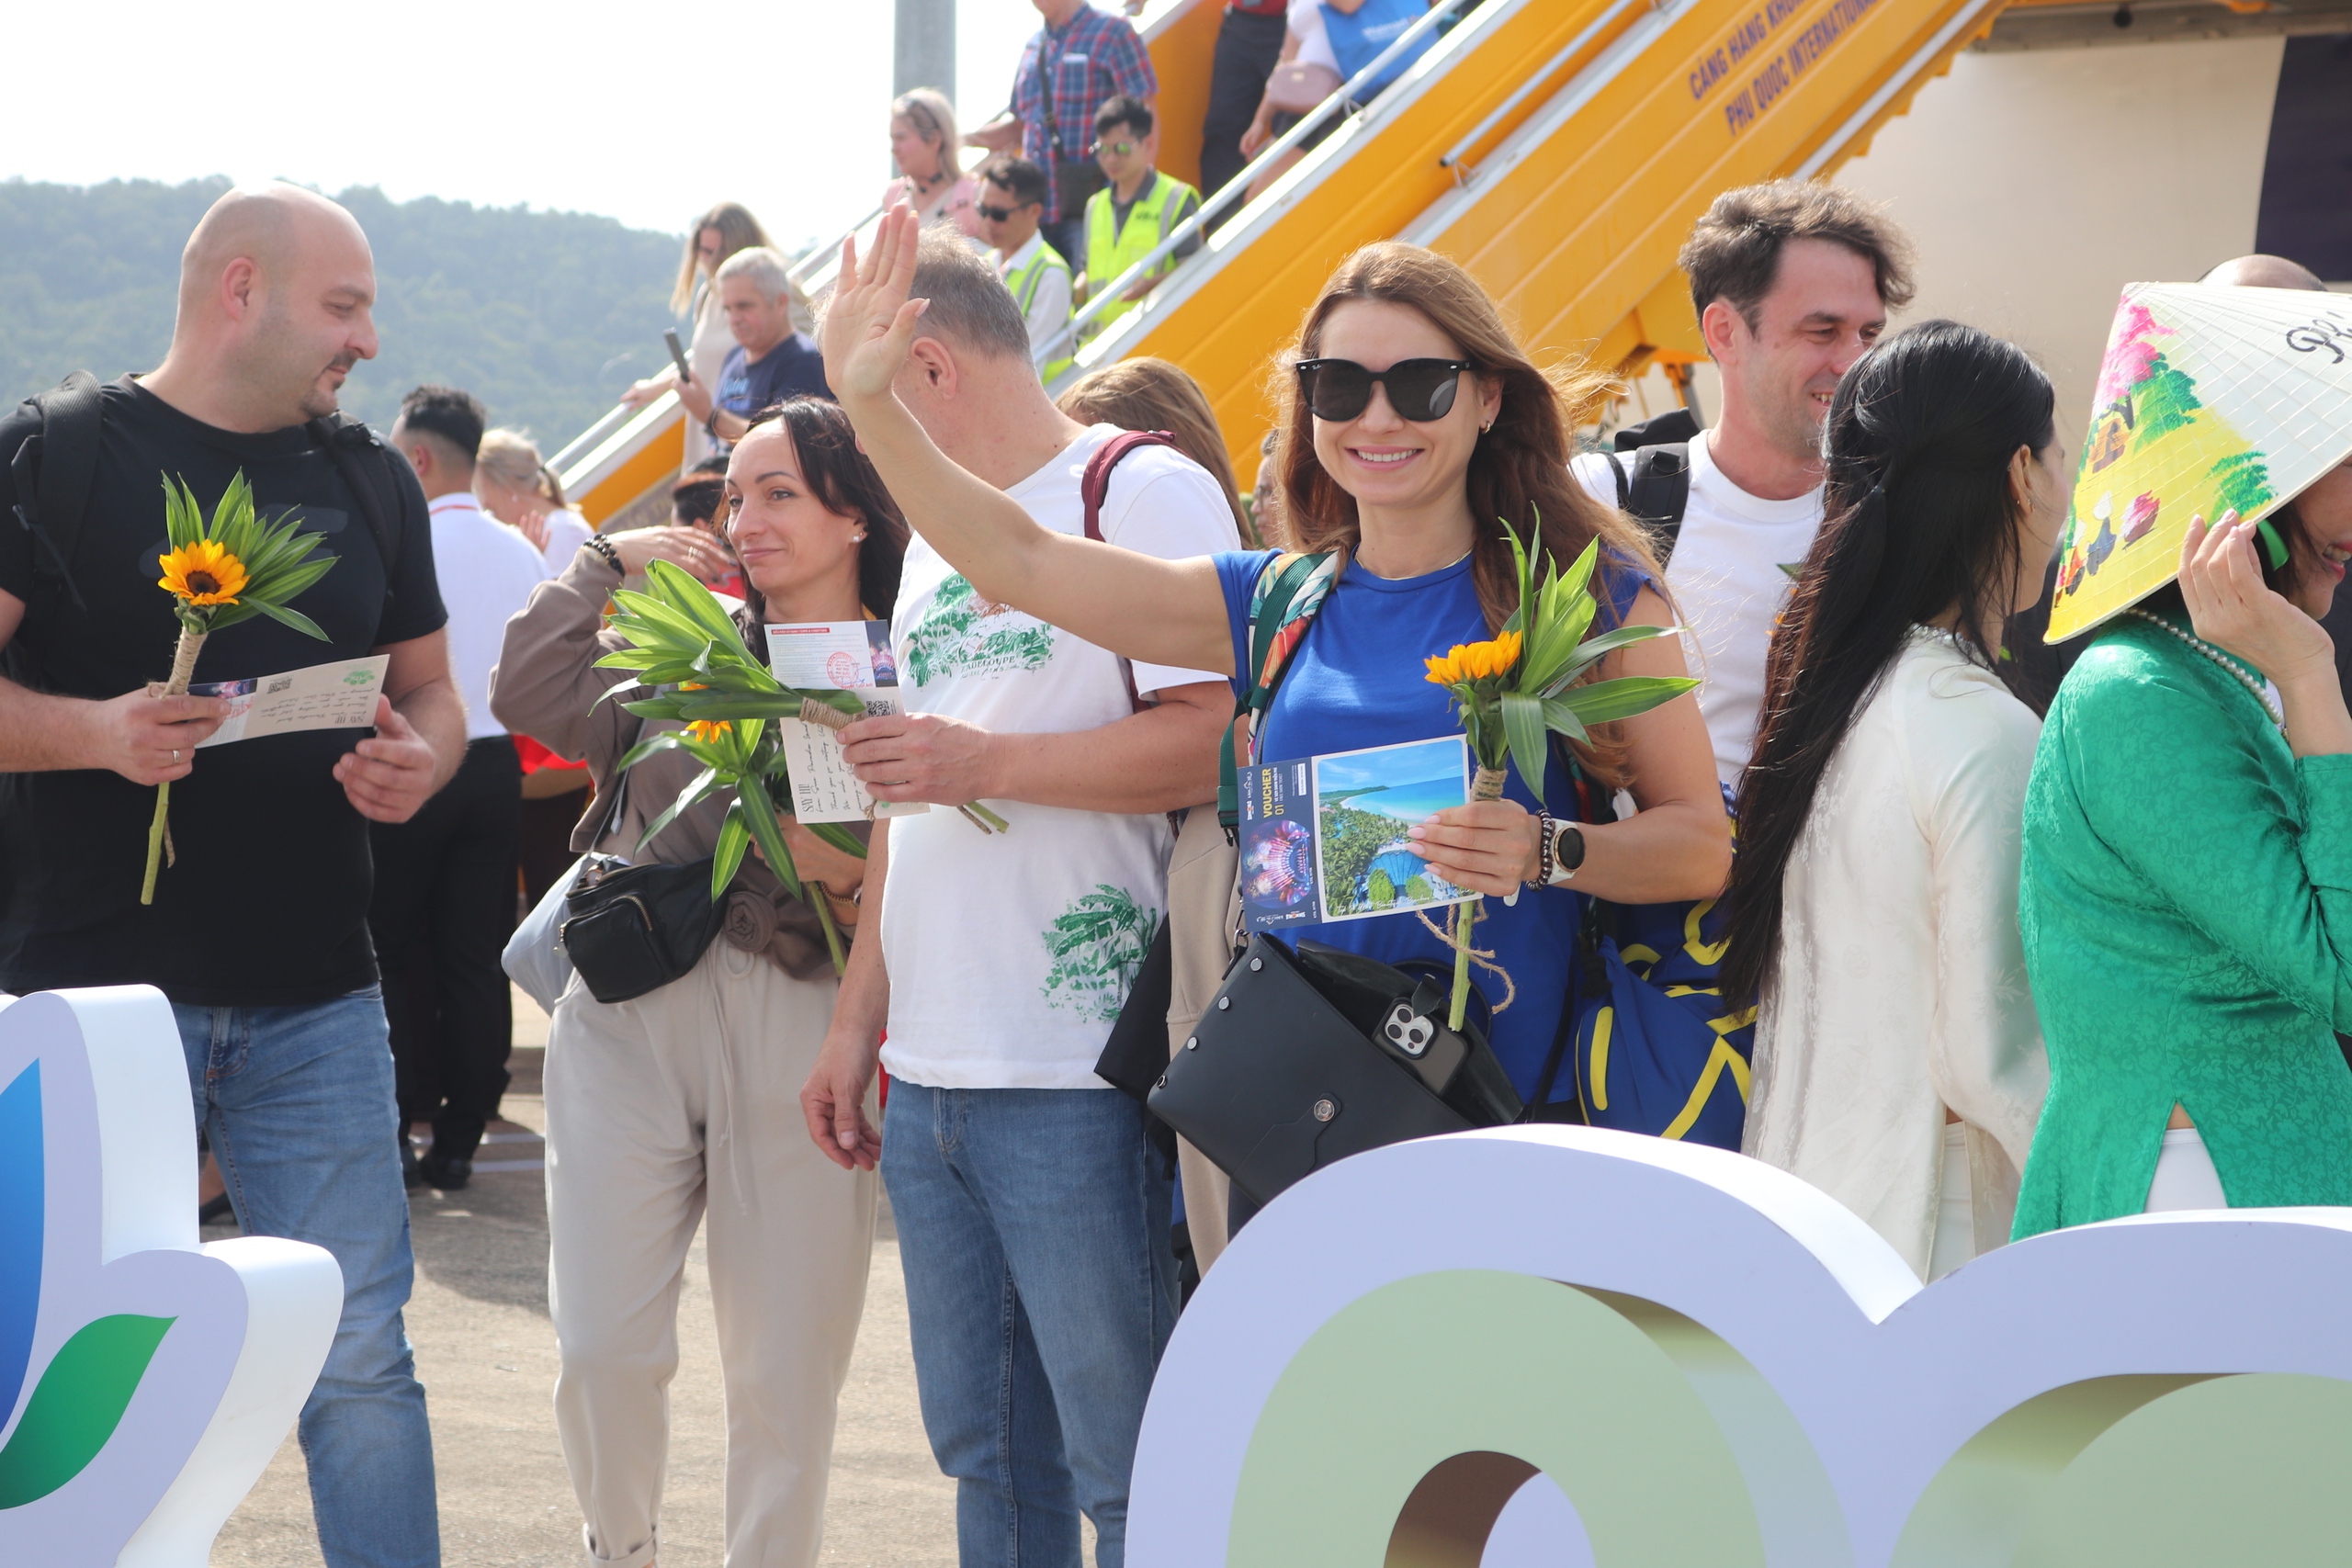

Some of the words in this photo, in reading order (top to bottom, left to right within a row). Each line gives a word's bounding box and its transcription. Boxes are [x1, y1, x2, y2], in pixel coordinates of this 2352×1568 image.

[798, 784, 811, 795] HI!
[1261, 768, 1272, 818] VOUCHER
[801, 796, 814, 813] SAY
[1274, 804, 1284, 816] 01
